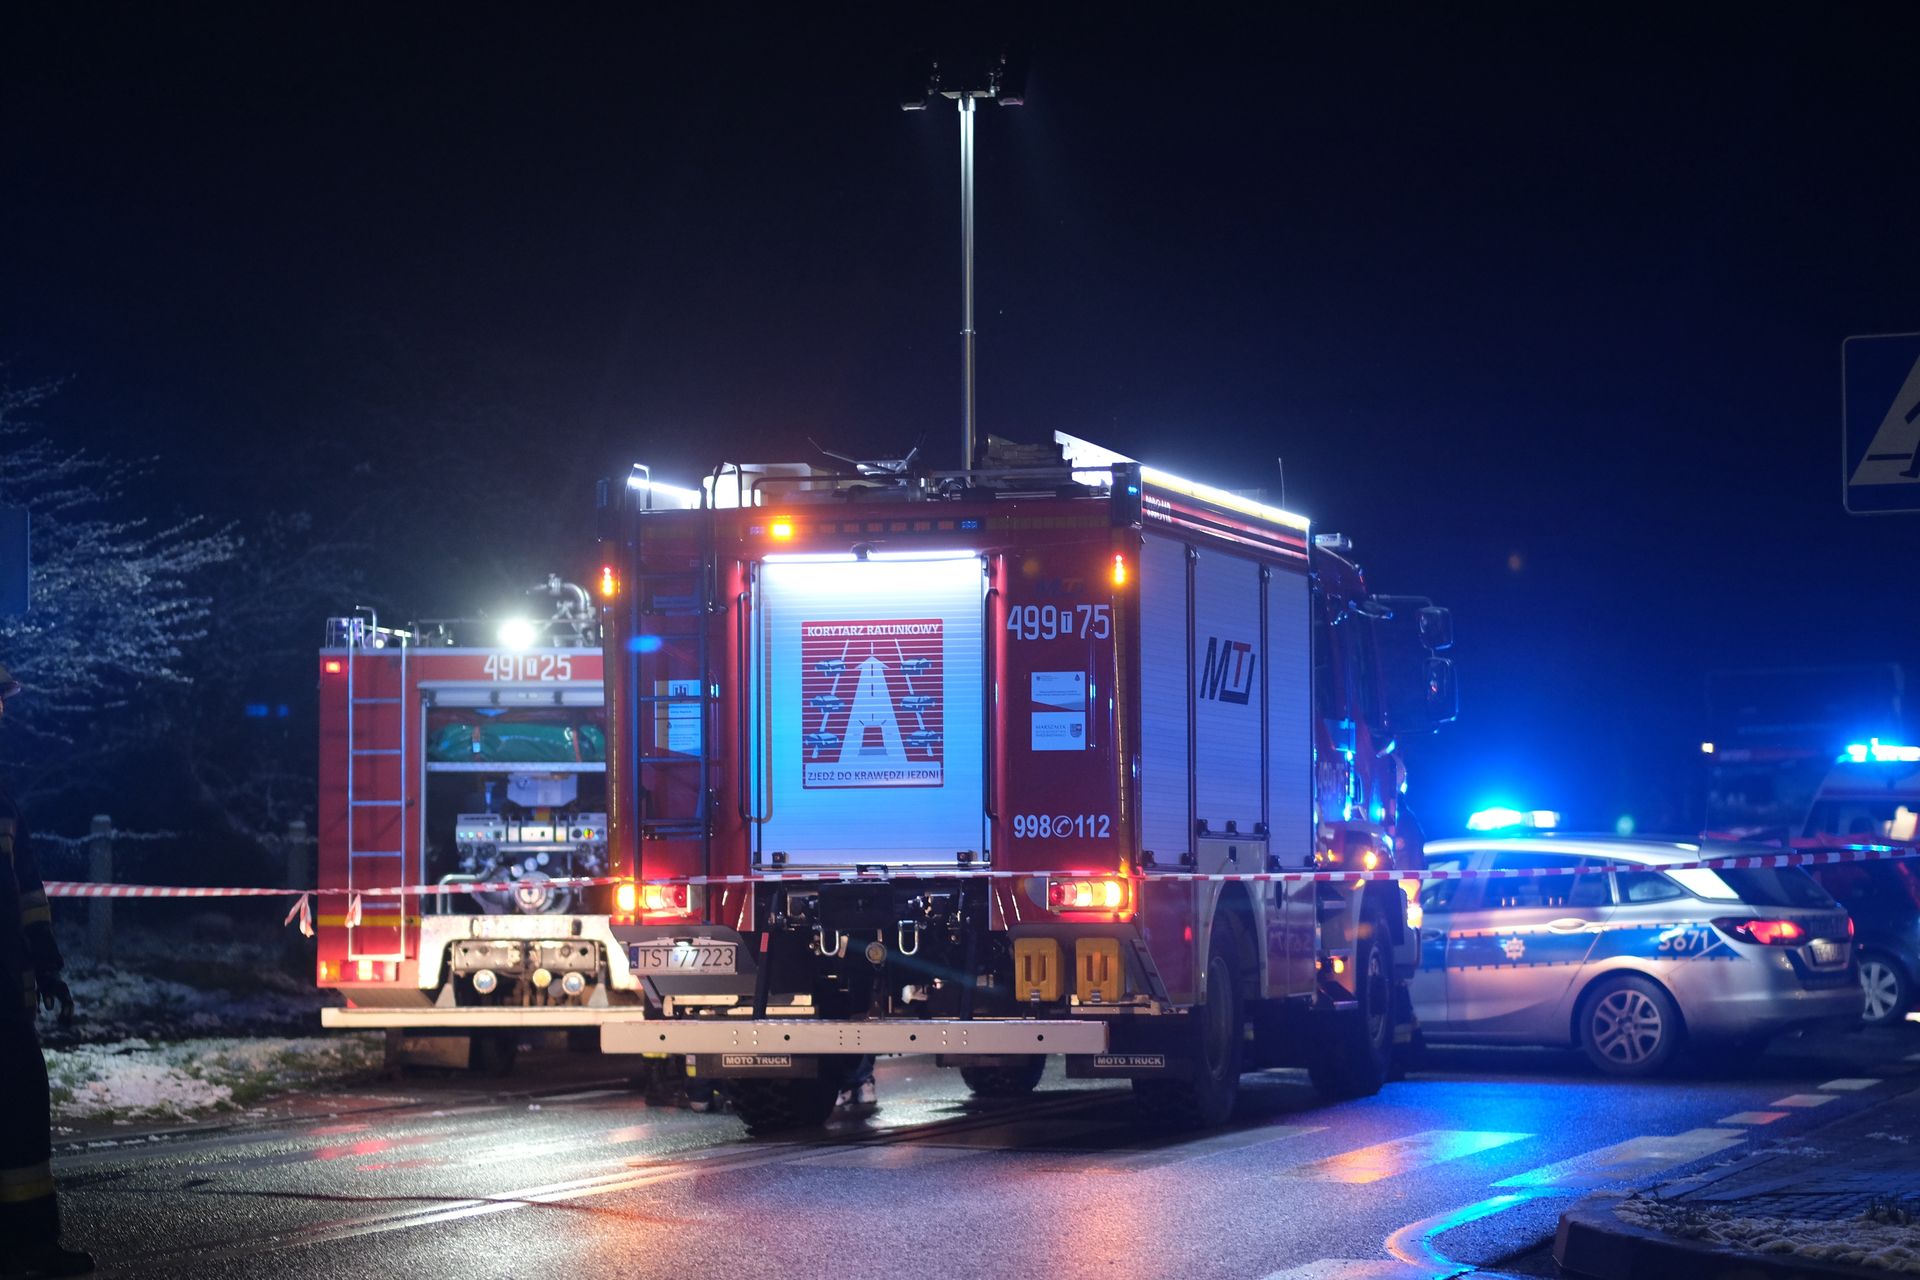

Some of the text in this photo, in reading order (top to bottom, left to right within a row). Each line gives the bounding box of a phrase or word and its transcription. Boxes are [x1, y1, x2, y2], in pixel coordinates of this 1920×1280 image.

[1007, 605, 1057, 640] 499
[1077, 604, 1110, 639] 75
[807, 623, 939, 637] KORYTARZ RATUNKOWY
[837, 770, 851, 780] DO
[1013, 814, 1110, 838] 998 112
[641, 948, 673, 968] TST
[726, 1056, 788, 1065] MOTO TRUCK
[1097, 1056, 1162, 1065] MOTO TRUCK
